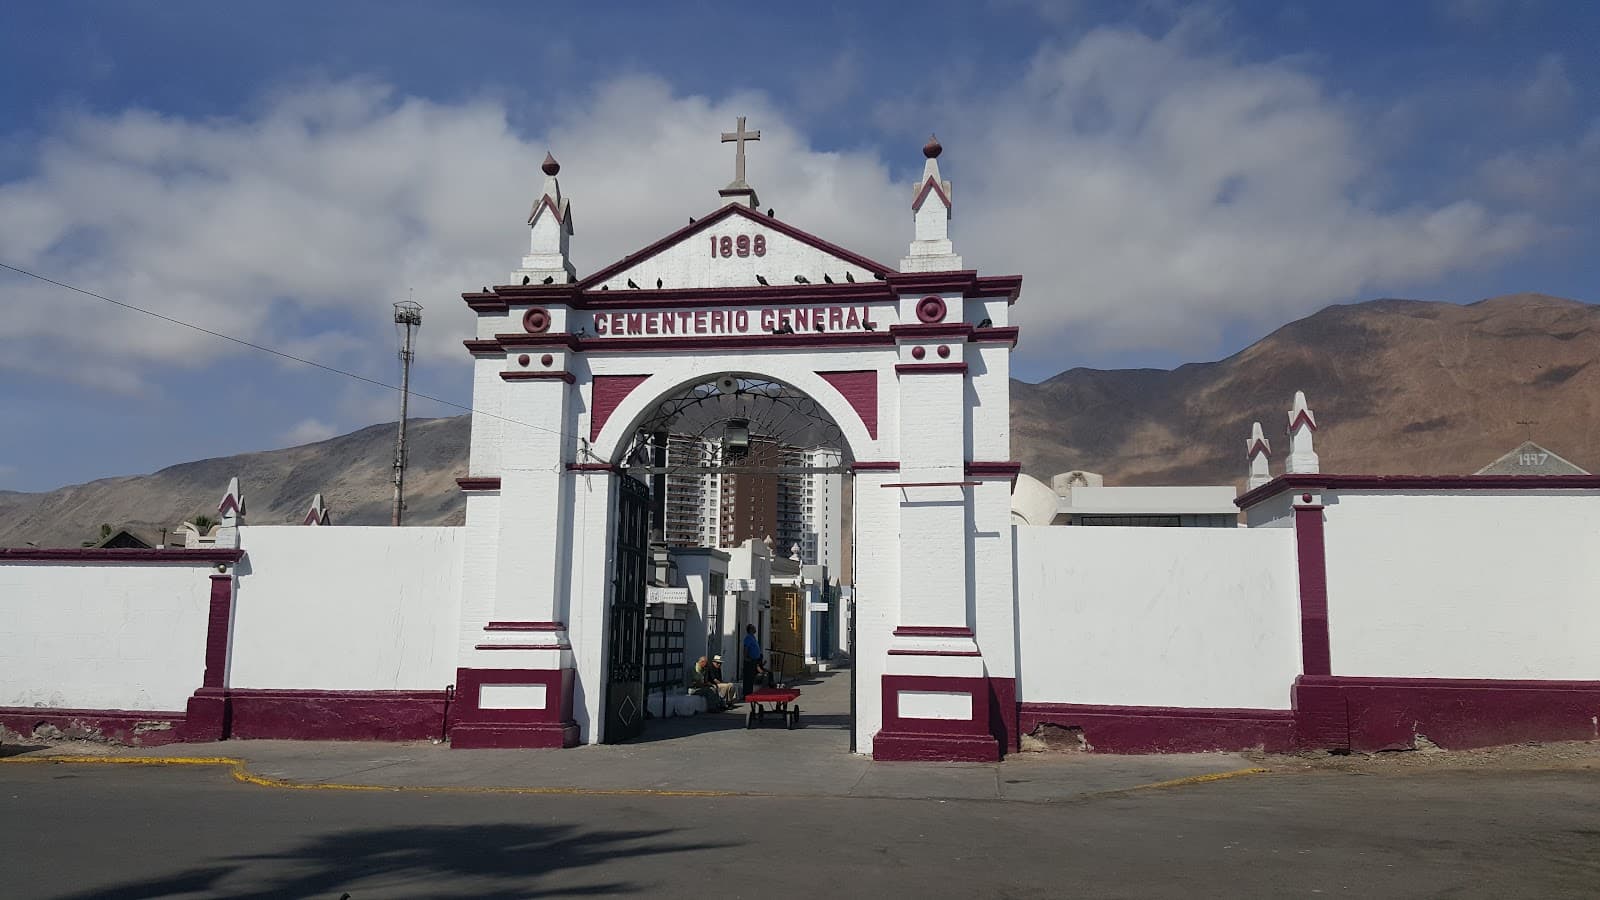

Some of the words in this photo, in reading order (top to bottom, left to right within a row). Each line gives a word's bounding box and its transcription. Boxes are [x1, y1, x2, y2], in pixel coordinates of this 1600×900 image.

[710, 234, 766, 258] 1898
[594, 310, 749, 335] CEMENTERIO
[761, 305, 877, 332] GENERAL
[1519, 453, 1548, 466] 1997
